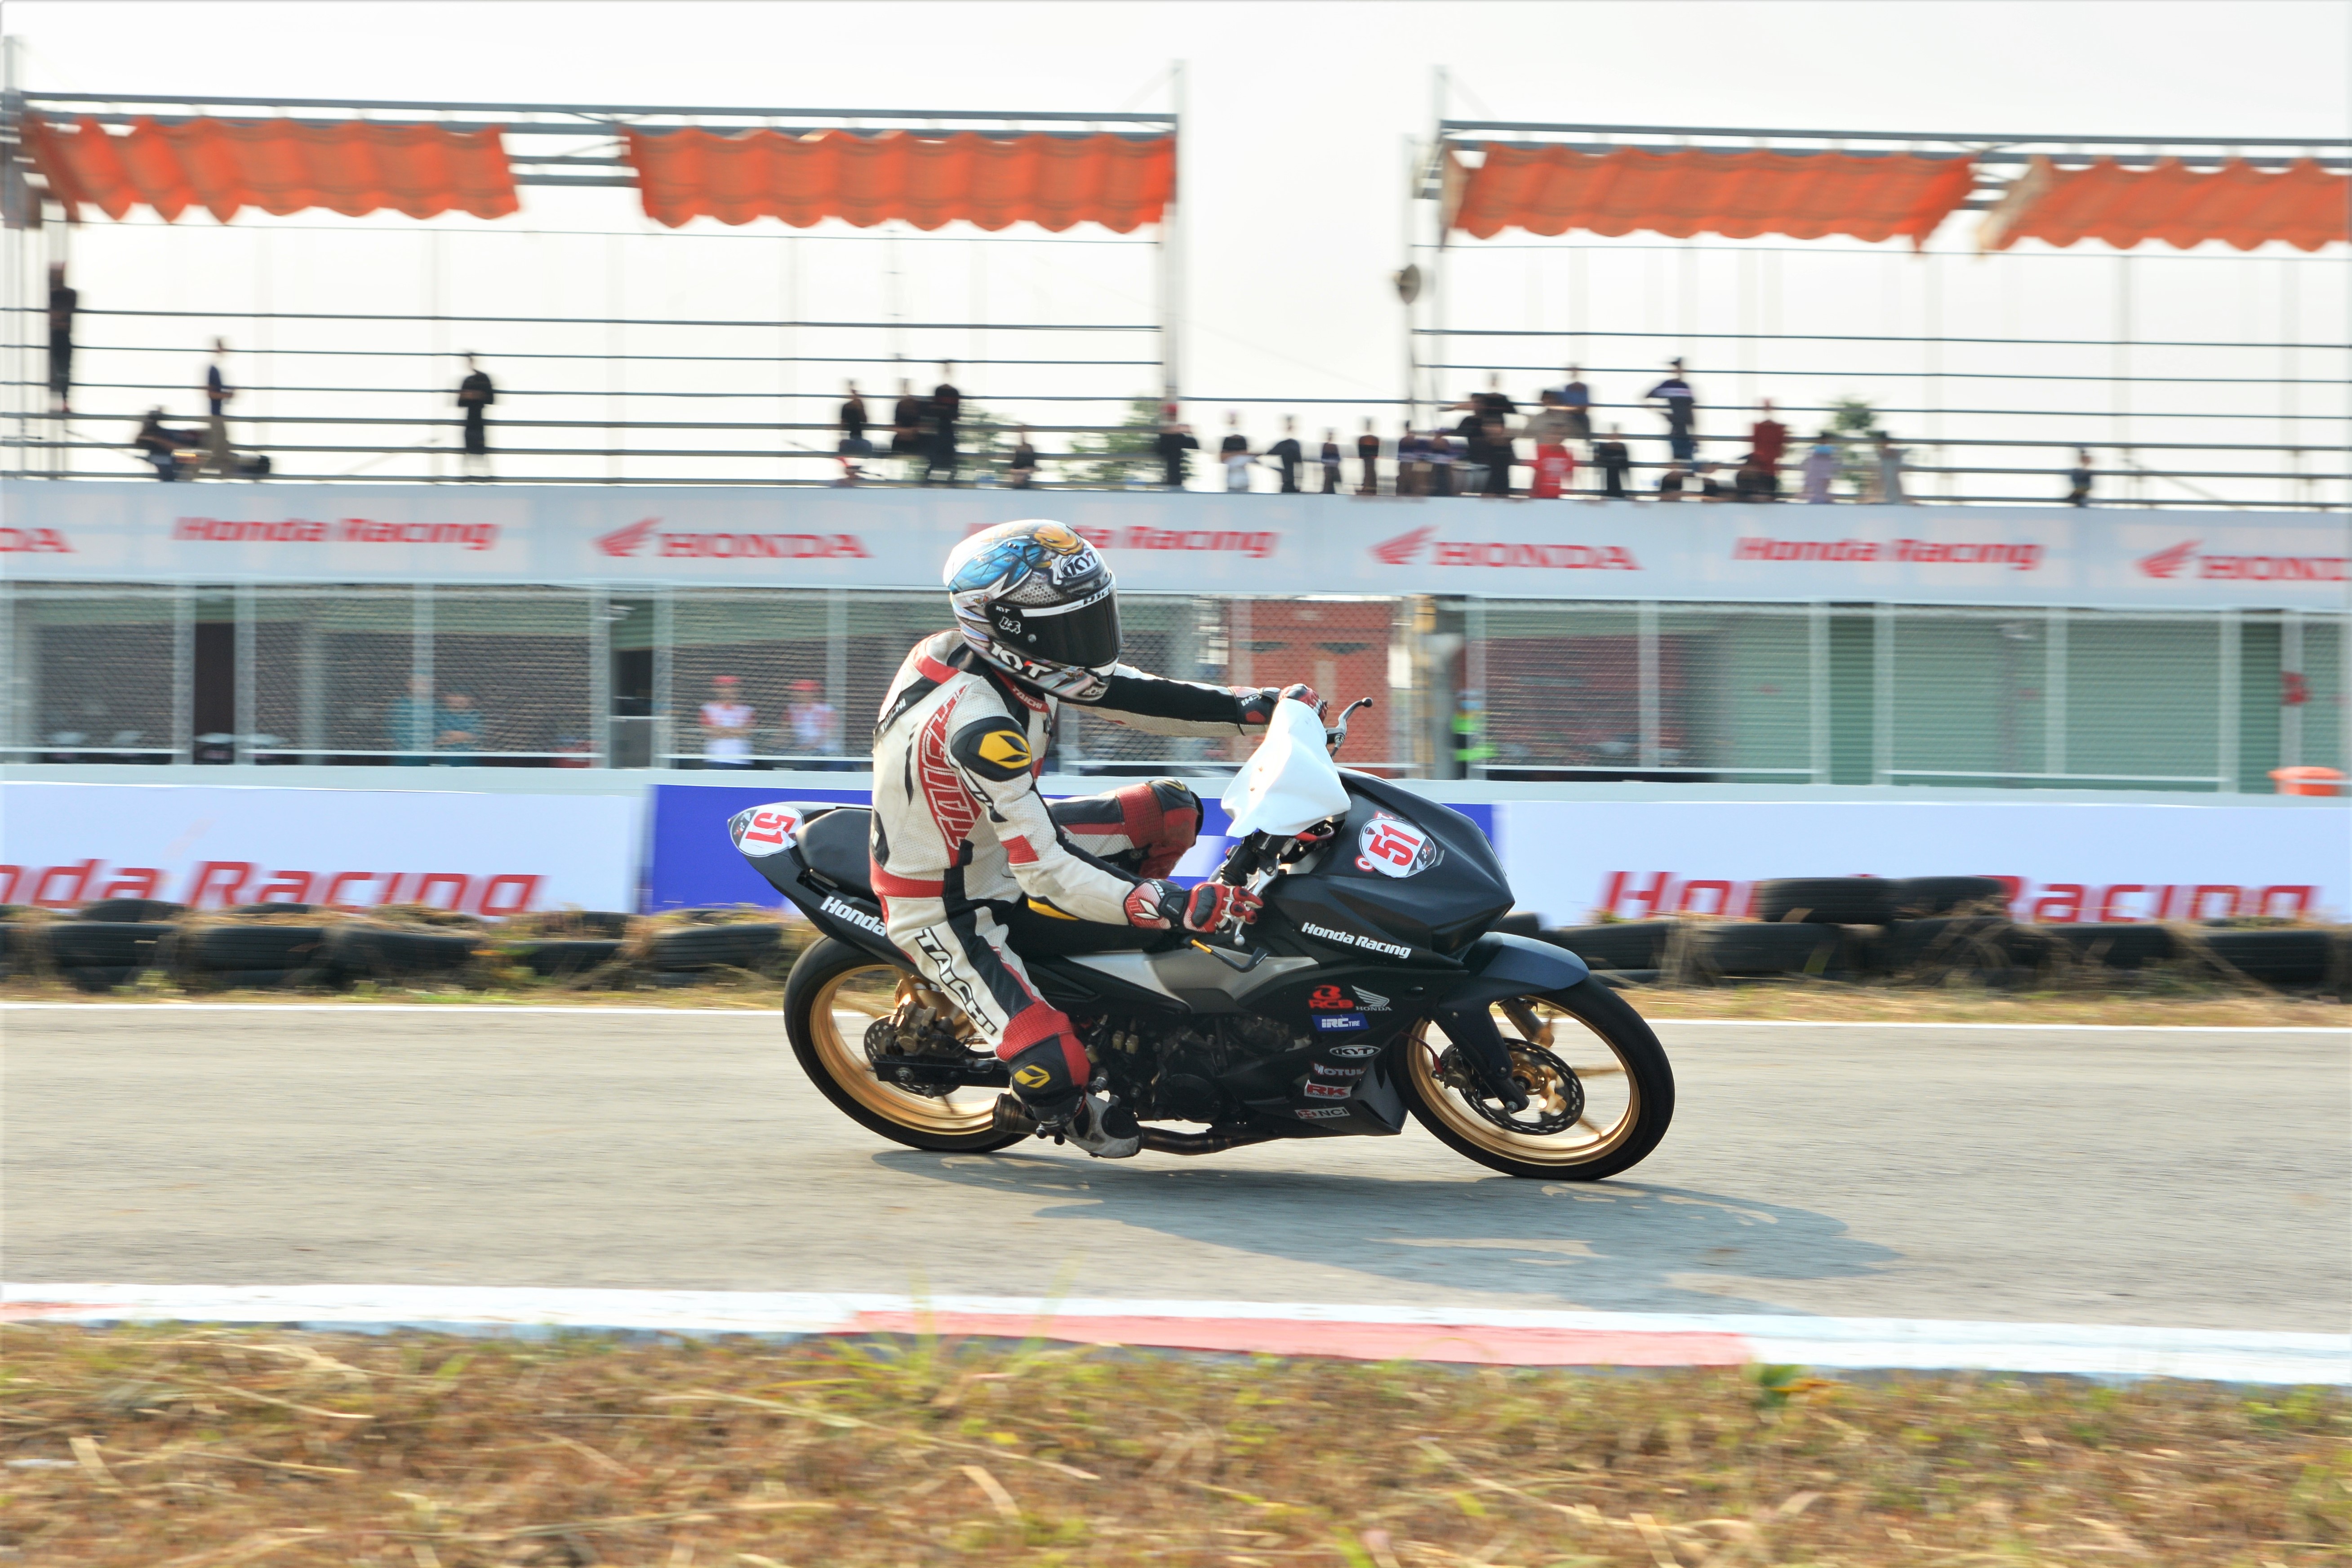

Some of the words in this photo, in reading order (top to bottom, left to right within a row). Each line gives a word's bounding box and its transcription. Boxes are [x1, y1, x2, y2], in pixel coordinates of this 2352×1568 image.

[173, 517, 326, 541] Honda
[337, 518, 502, 551] Racing
[655, 533, 873, 558] HONDA
[1125, 525, 1279, 558] Racing
[1065, 552, 1097, 576] KYT
[1432, 542, 1643, 570] HONDA
[1732, 537, 1881, 561] Honda
[1890, 538, 2047, 571] Racing
[996, 605, 1010, 613] KYT
[991, 643, 1054, 679] KYT
[1012, 686, 1043, 709] TAICHI
[881, 698, 907, 733] TAICHI
[745, 812, 797, 845] 51
[1369, 824, 1422, 866] 51
[820, 896, 887, 937] Honda
[1301, 922, 1355, 945] Honda
[1356, 936, 1412, 959] Racing
[914, 927, 999, 1035] TAICHI
[1308, 999, 1355, 1009] RCB
[1337, 1048, 1371, 1056] KYT
[1307, 1084, 1348, 1094] RK
[1319, 1106, 1348, 1116] NCI
